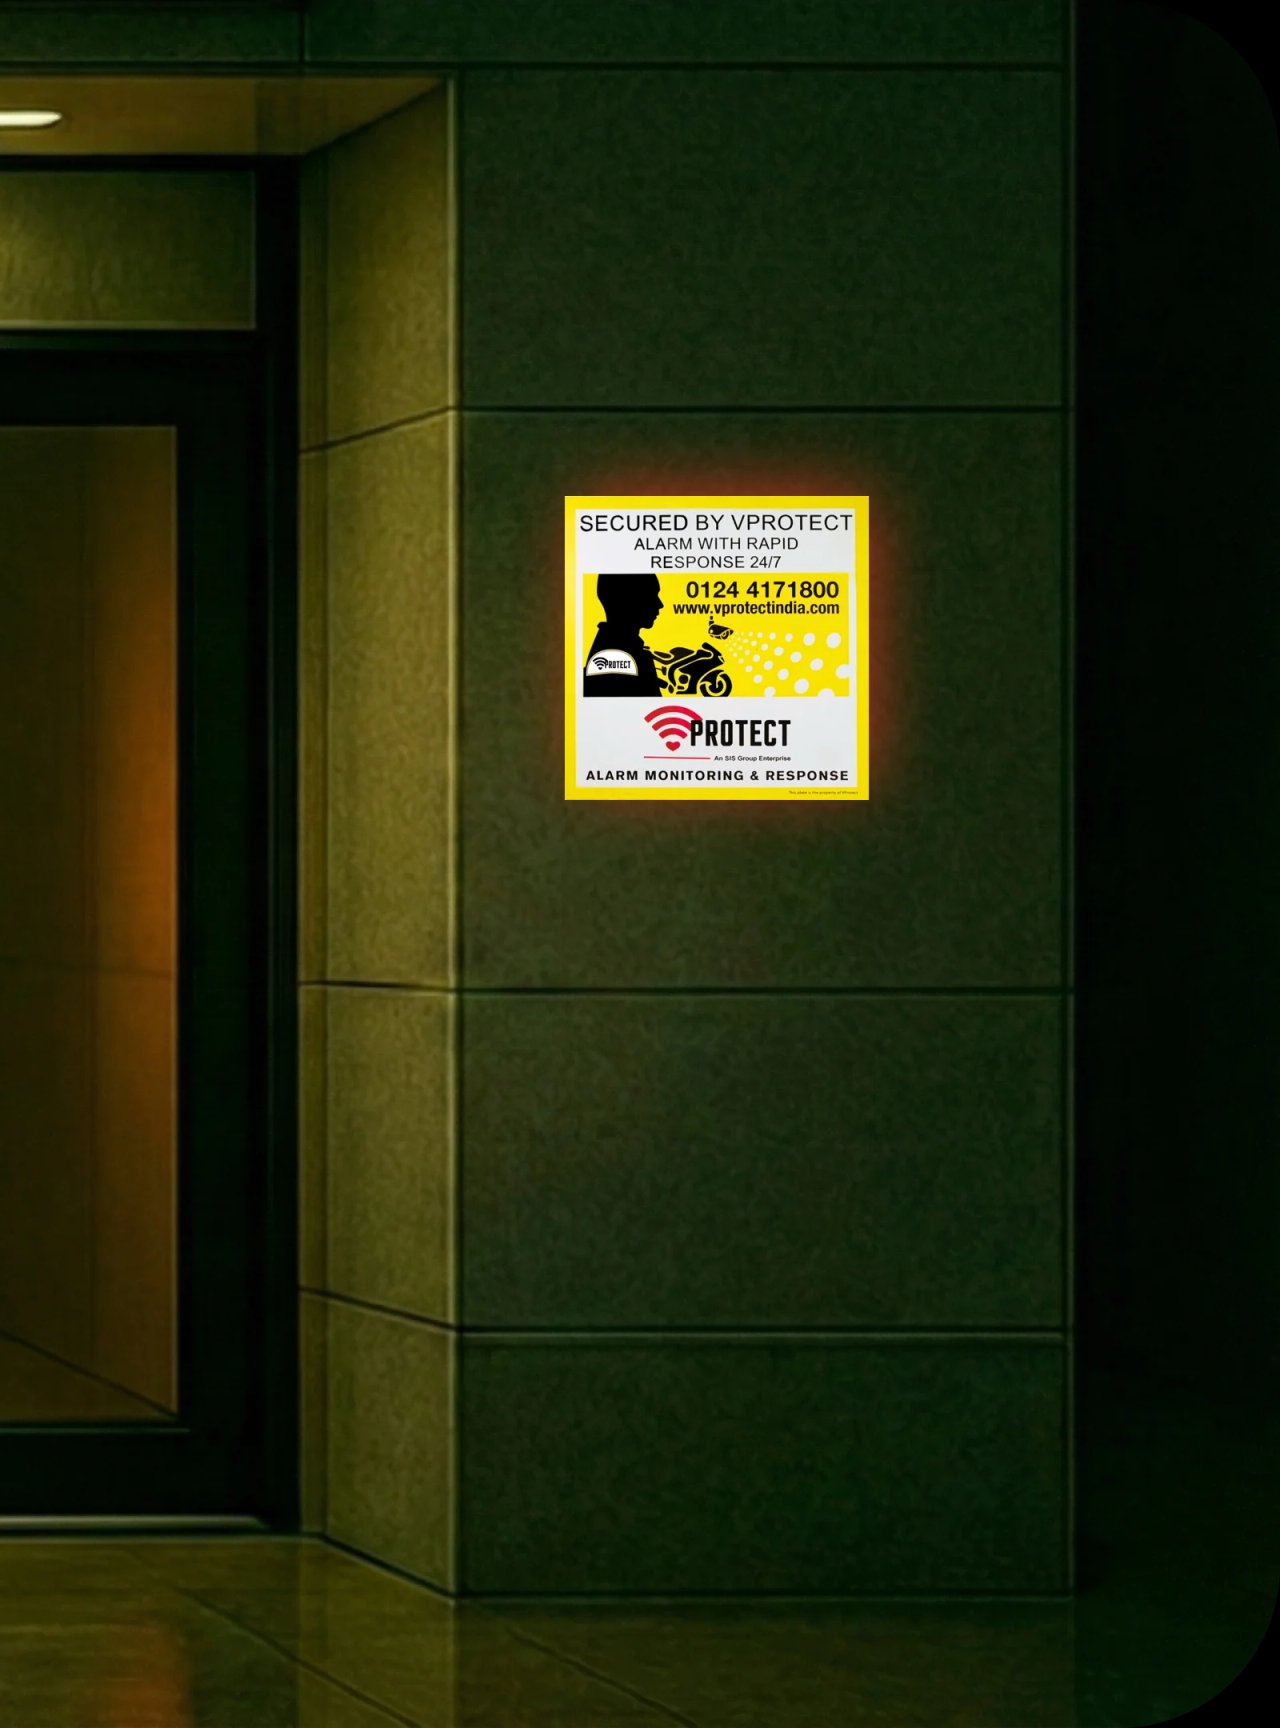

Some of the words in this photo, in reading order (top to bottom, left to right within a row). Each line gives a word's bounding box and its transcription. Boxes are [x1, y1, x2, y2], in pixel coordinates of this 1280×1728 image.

[580, 514, 689, 532] SECURED
[695, 514, 725, 531] BY
[730, 514, 853, 531] VPROTECT
[633, 537, 692, 551] ALARM
[697, 537, 741, 550] WITH
[747, 537, 799, 550] RAPID
[650, 555, 745, 569] RESPONSE
[750, 555, 782, 569] 24/7
[686, 580, 740, 599] 0124
[746, 580, 840, 599] 4171800
[672, 601, 840, 617] www.vprotectindia.com
[585, 770, 638, 781] ALARM
[644, 770, 744, 781] MONITORING
[749, 770, 760, 781] &
[765, 770, 849, 781] RESPONSE
